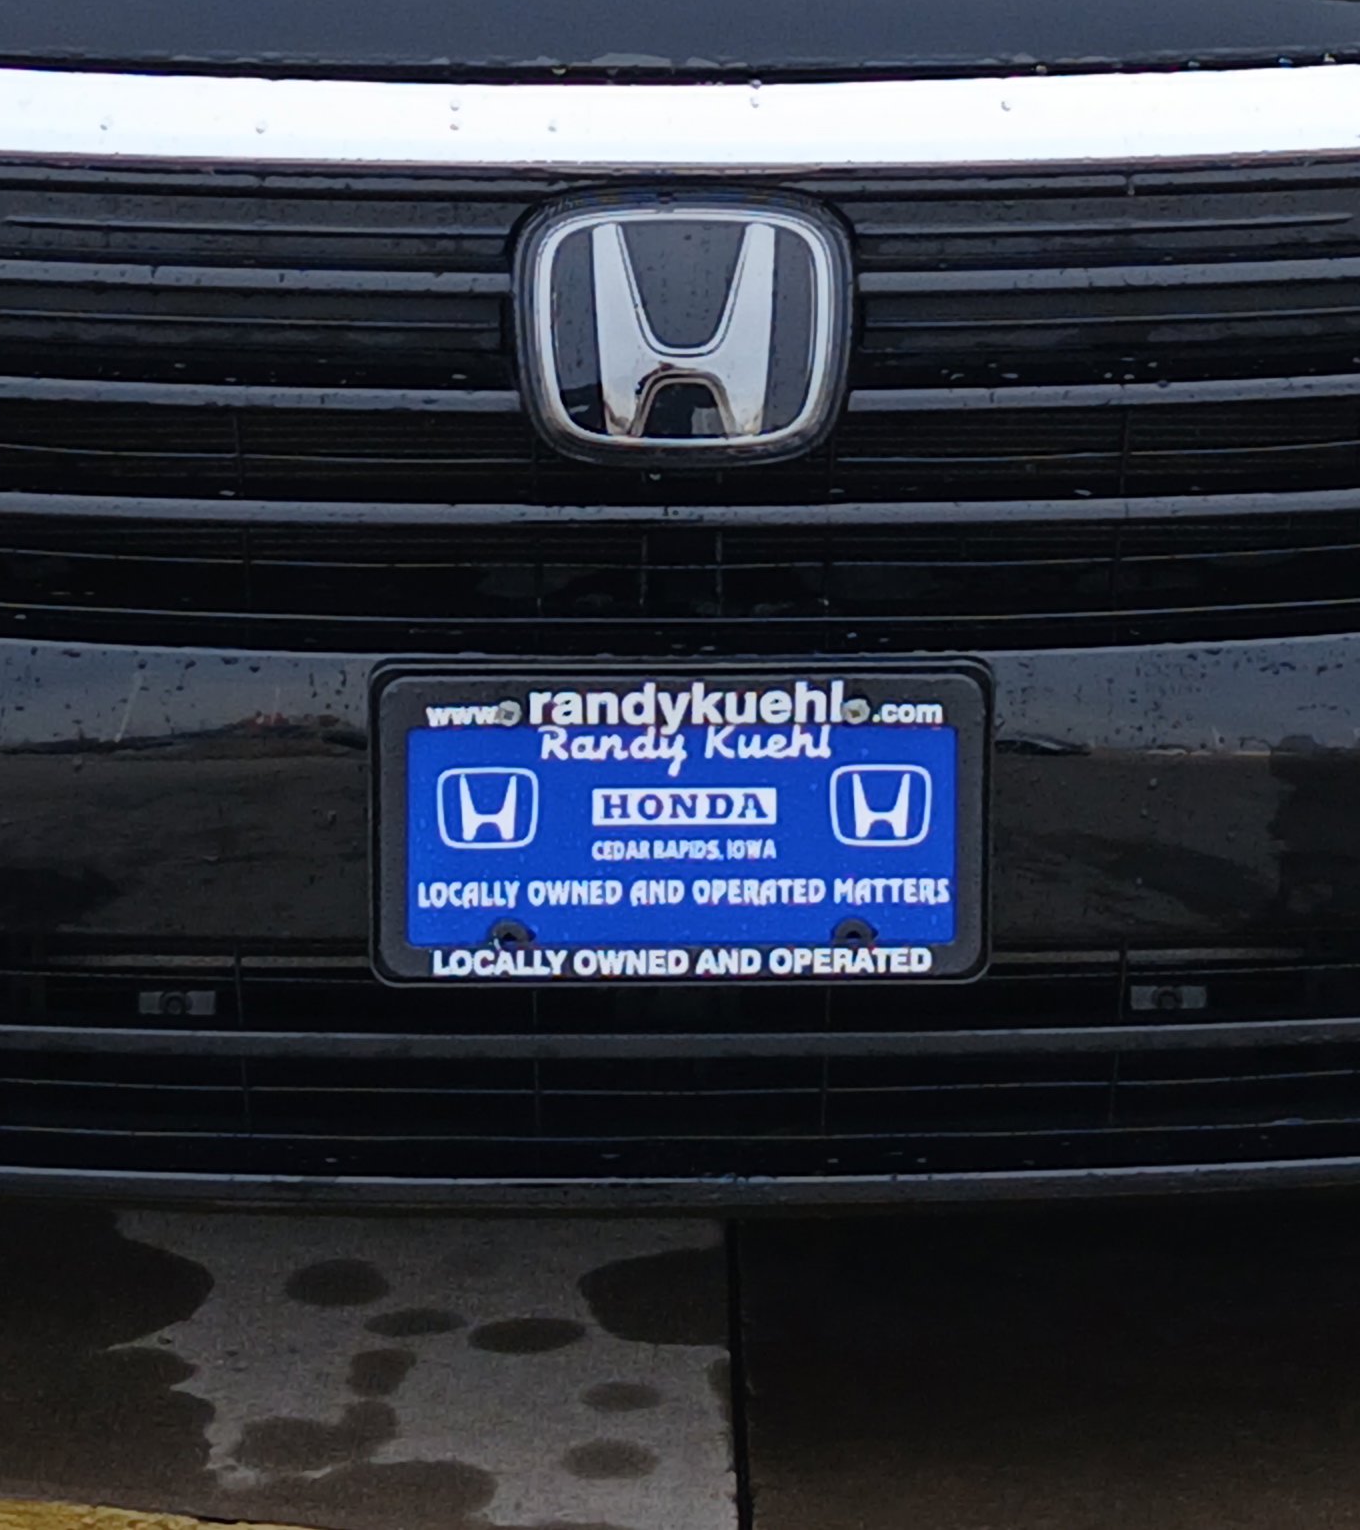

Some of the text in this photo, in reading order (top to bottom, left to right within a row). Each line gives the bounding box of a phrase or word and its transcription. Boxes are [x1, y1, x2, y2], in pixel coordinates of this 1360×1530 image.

[538, 724, 831, 776] Randy Kuehl
[601, 793, 768, 820] HONDA
[592, 839, 650, 861] CEDAR
[727, 838, 777, 860] IOWA
[418, 878, 950, 909] LOCALLY OWNED AND OPERATED MATTERS
[433, 948, 932, 976] LOCALLY OWNED AND OPERATED
